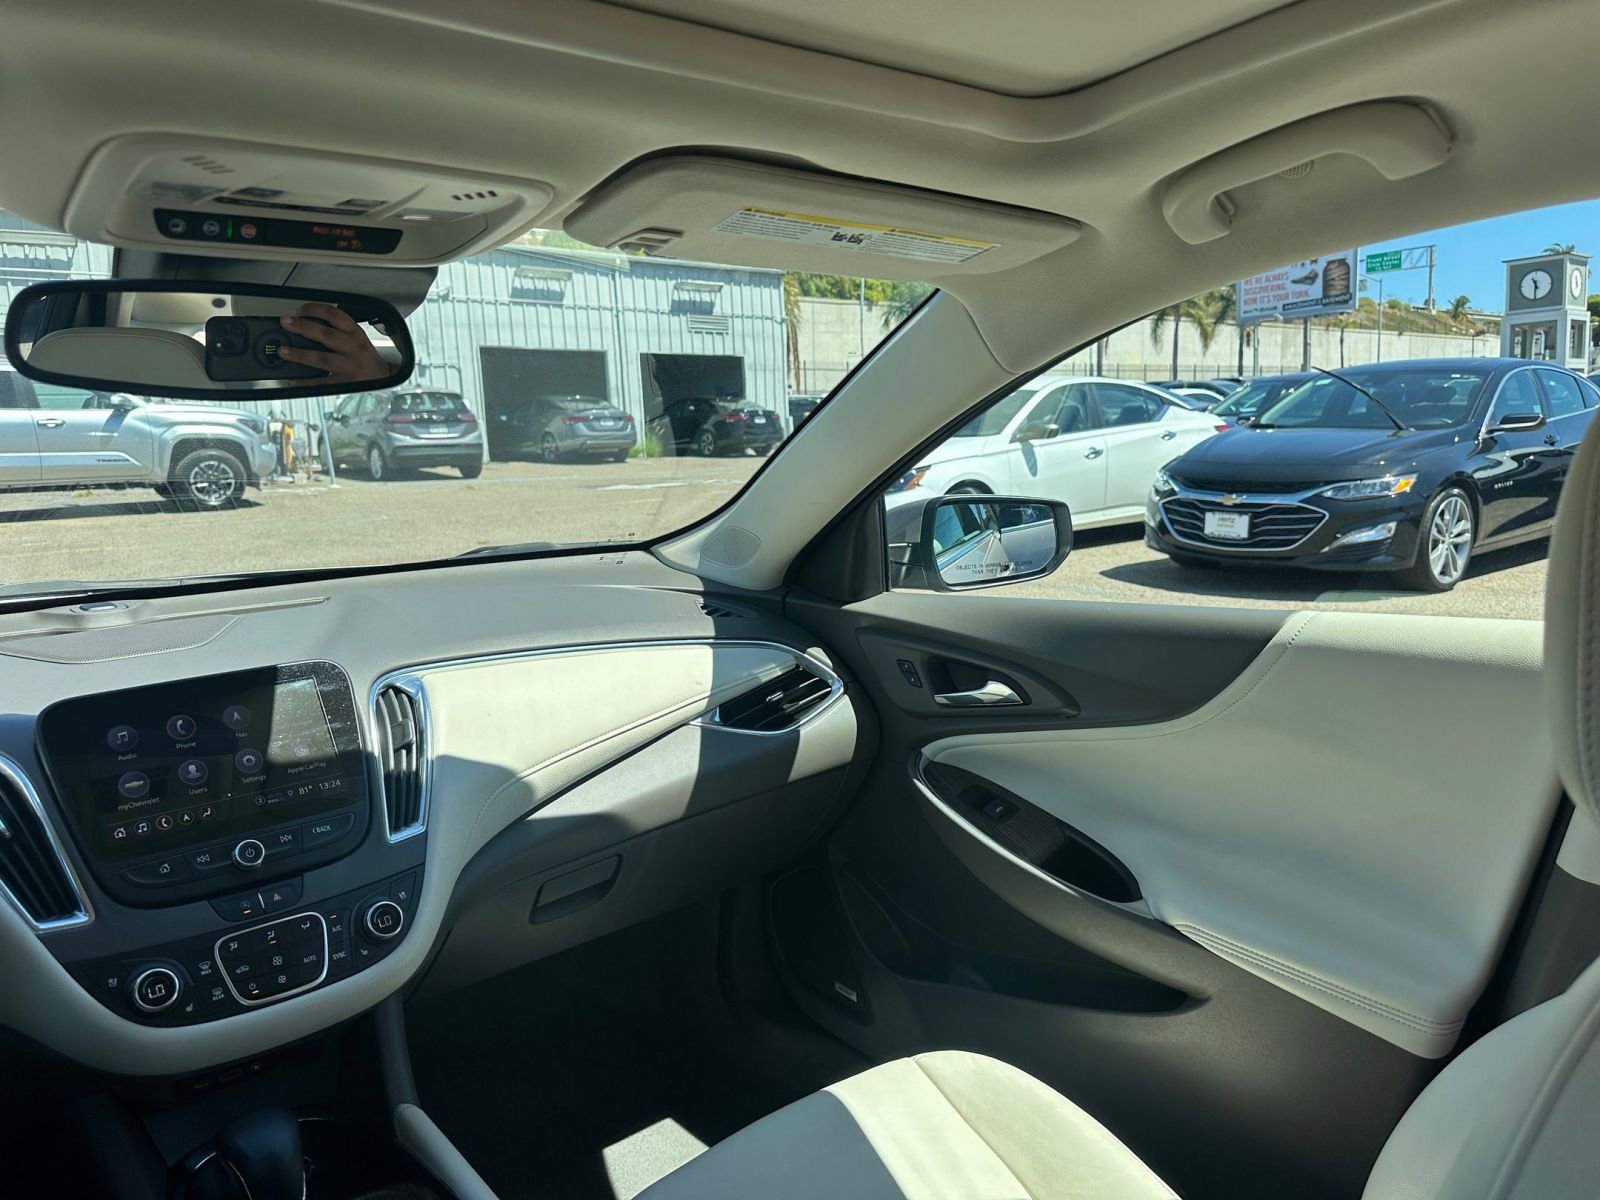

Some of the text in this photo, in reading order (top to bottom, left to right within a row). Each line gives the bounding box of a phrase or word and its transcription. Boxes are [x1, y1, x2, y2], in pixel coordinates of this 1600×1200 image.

[176, 742, 197, 750] Phone
[118, 753, 138, 761] Audio
[288, 761, 327, 774] Apple CarPlay
[242, 774, 266, 784] Settings
[318, 779, 341, 790] 13:24
[188, 787, 208, 796] Users
[118, 796, 160, 811] myChevrolet
[304, 955, 317, 964] AUTO
[332, 950, 347, 960] SYNC
